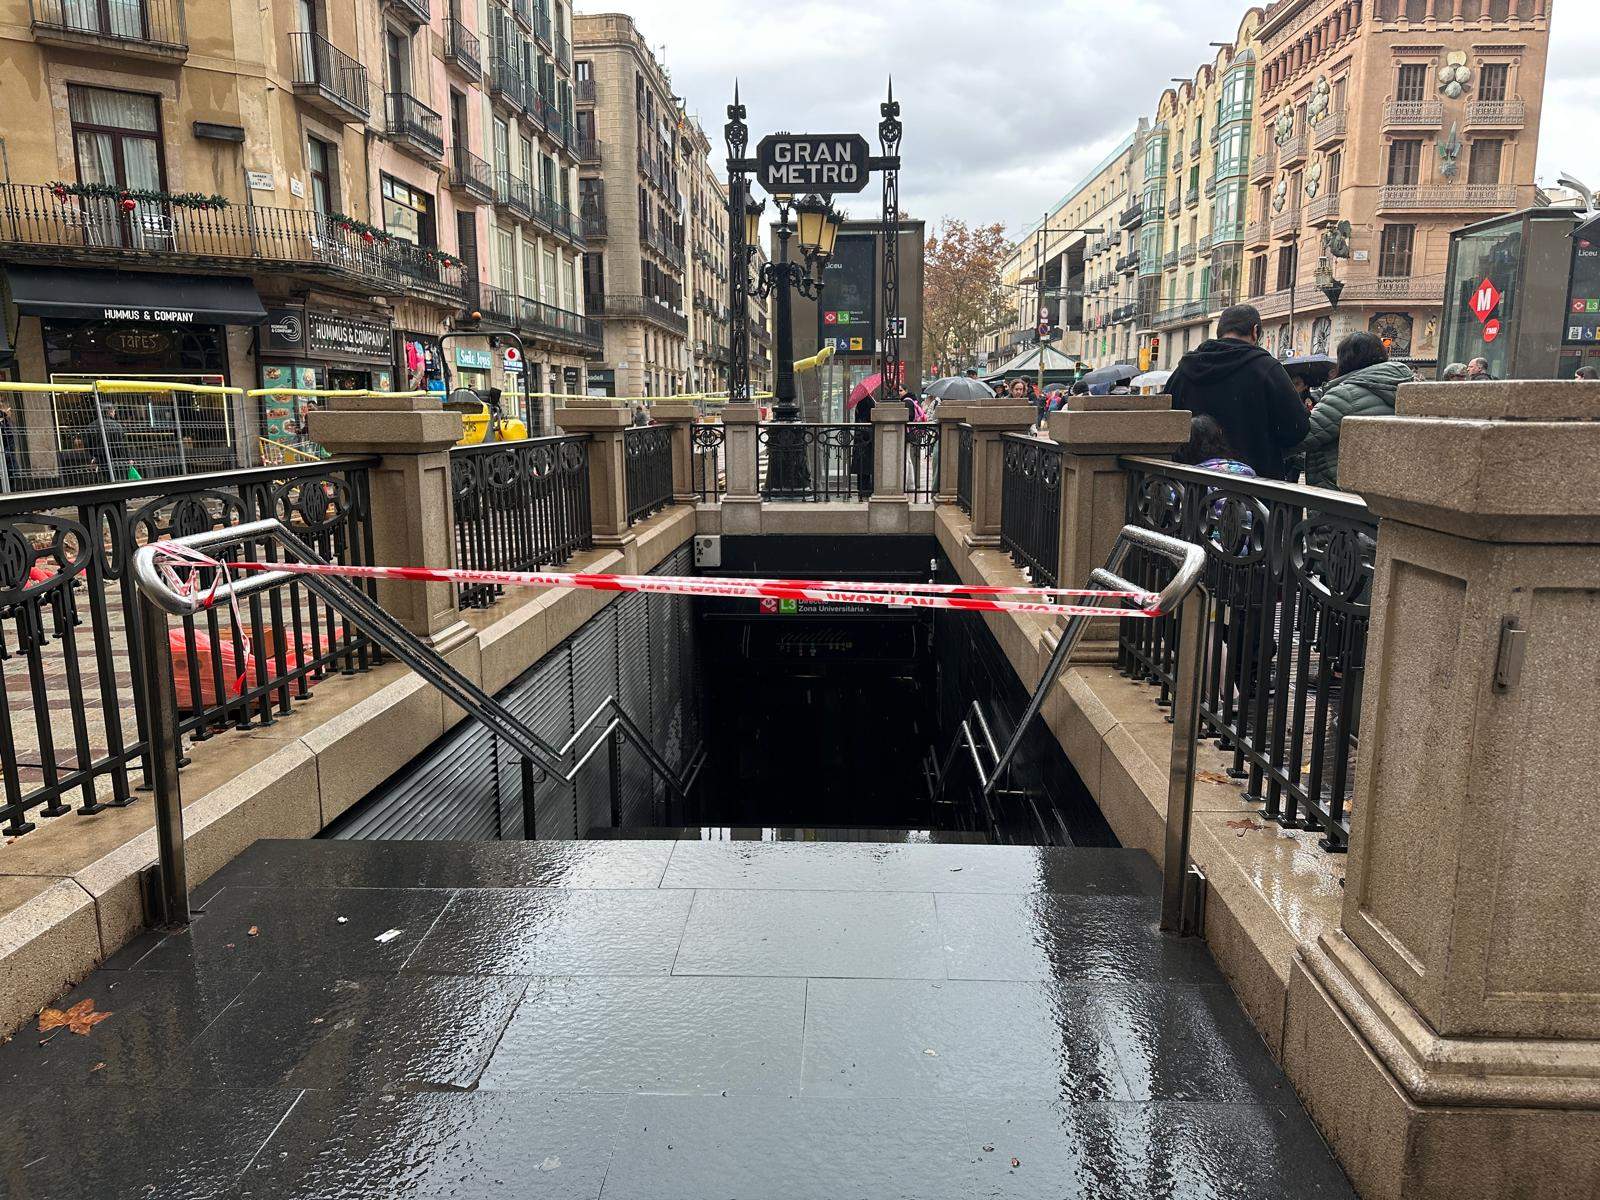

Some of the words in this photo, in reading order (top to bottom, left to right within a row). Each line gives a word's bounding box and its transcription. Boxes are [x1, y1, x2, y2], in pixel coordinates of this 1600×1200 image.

[774, 142, 851, 162] GRAN
[768, 164, 857, 183] METRO
[1477, 288, 1491, 311] M
[1586, 302, 1598, 310] L3
[104, 309, 140, 320] HUMMUS
[143, 310, 151, 320] &
[154, 311, 194, 322] COMPANY
[838, 312, 849, 322] L3
[316, 323, 347, 341] HUMMUS
[348, 327, 354, 343] &
[354, 329, 384, 347] COMPANY
[780, 599, 796, 610] L3
[818, 604, 864, 612] Universitària
